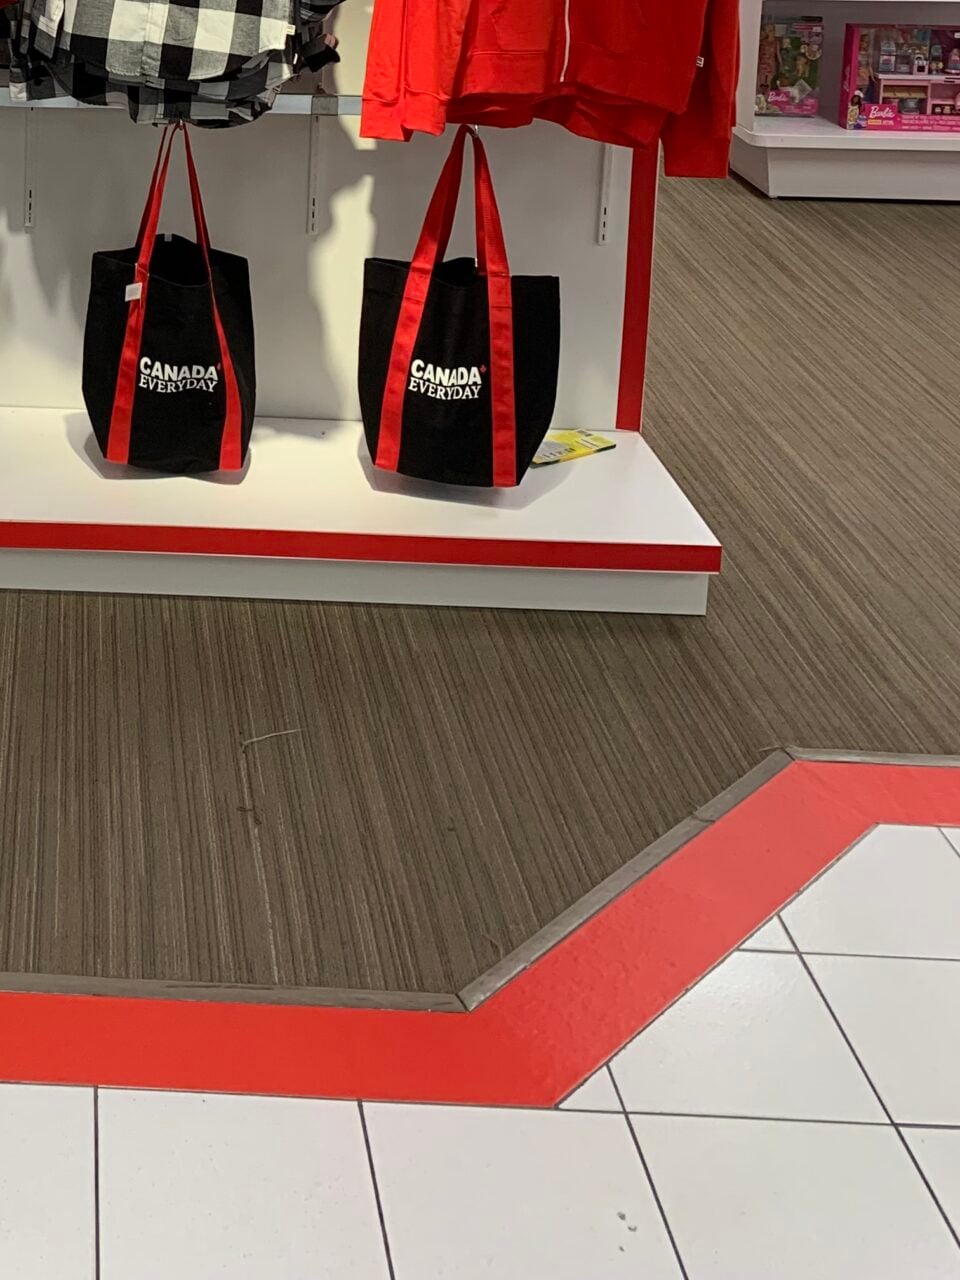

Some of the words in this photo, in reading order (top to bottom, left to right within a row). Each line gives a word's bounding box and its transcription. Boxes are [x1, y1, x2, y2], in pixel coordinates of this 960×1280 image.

[139, 356, 219, 381] CANADA
[410, 358, 482, 387] CANADA
[138, 374, 218, 393] EVERYDAY
[407, 376, 482, 400] EVERYDAY
